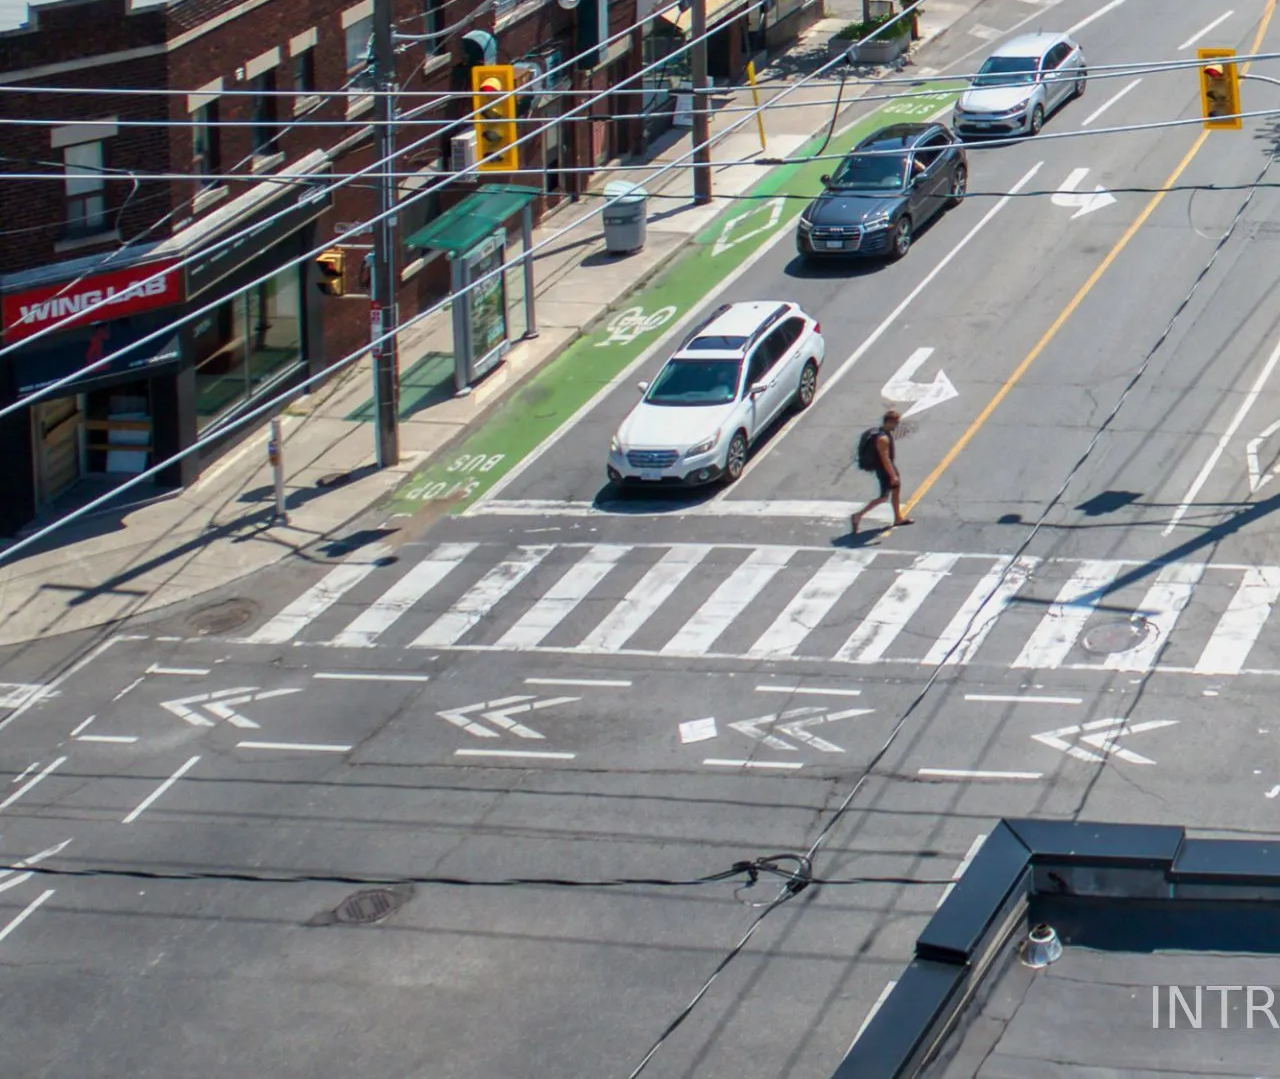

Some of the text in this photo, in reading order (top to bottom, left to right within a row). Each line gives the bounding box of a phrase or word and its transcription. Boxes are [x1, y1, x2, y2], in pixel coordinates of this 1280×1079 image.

[20, 275, 167, 324] WING LAB
[446, 453, 506, 472] BUS
[405, 477, 481, 500] STOP
